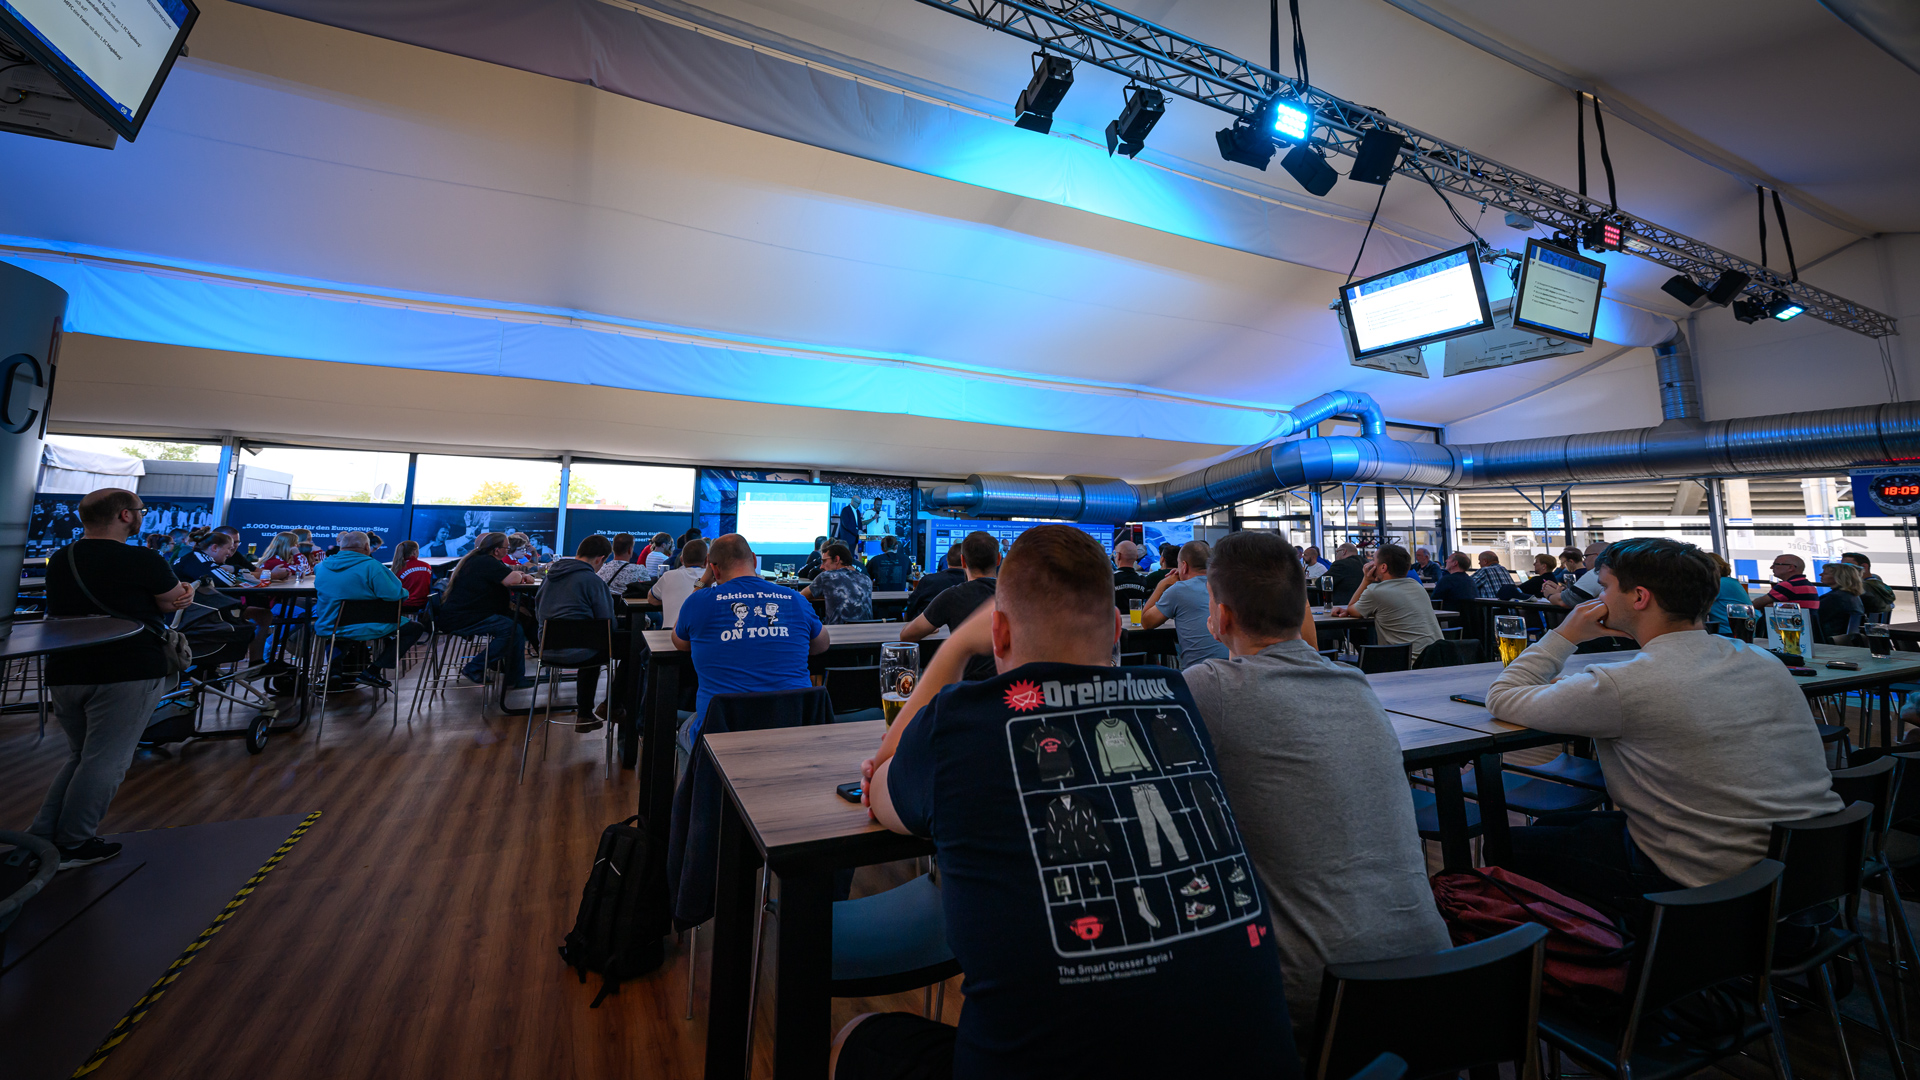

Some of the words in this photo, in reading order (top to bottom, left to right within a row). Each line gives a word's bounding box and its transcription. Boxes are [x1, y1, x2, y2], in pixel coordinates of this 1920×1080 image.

[1884, 485, 1919, 495] 18:09
[331, 525, 389, 533] Europacup-Sieg
[716, 592, 755, 601] Sektion
[756, 591, 792, 600] Twitter
[720, 629, 744, 642] ON
[747, 626, 790, 638] TOUR
[1058, 966, 1075, 976] The
[1078, 964, 1106, 975] Smart
[1109, 959, 1144, 971] Dresser
[1146, 953, 1168, 965] Serie
